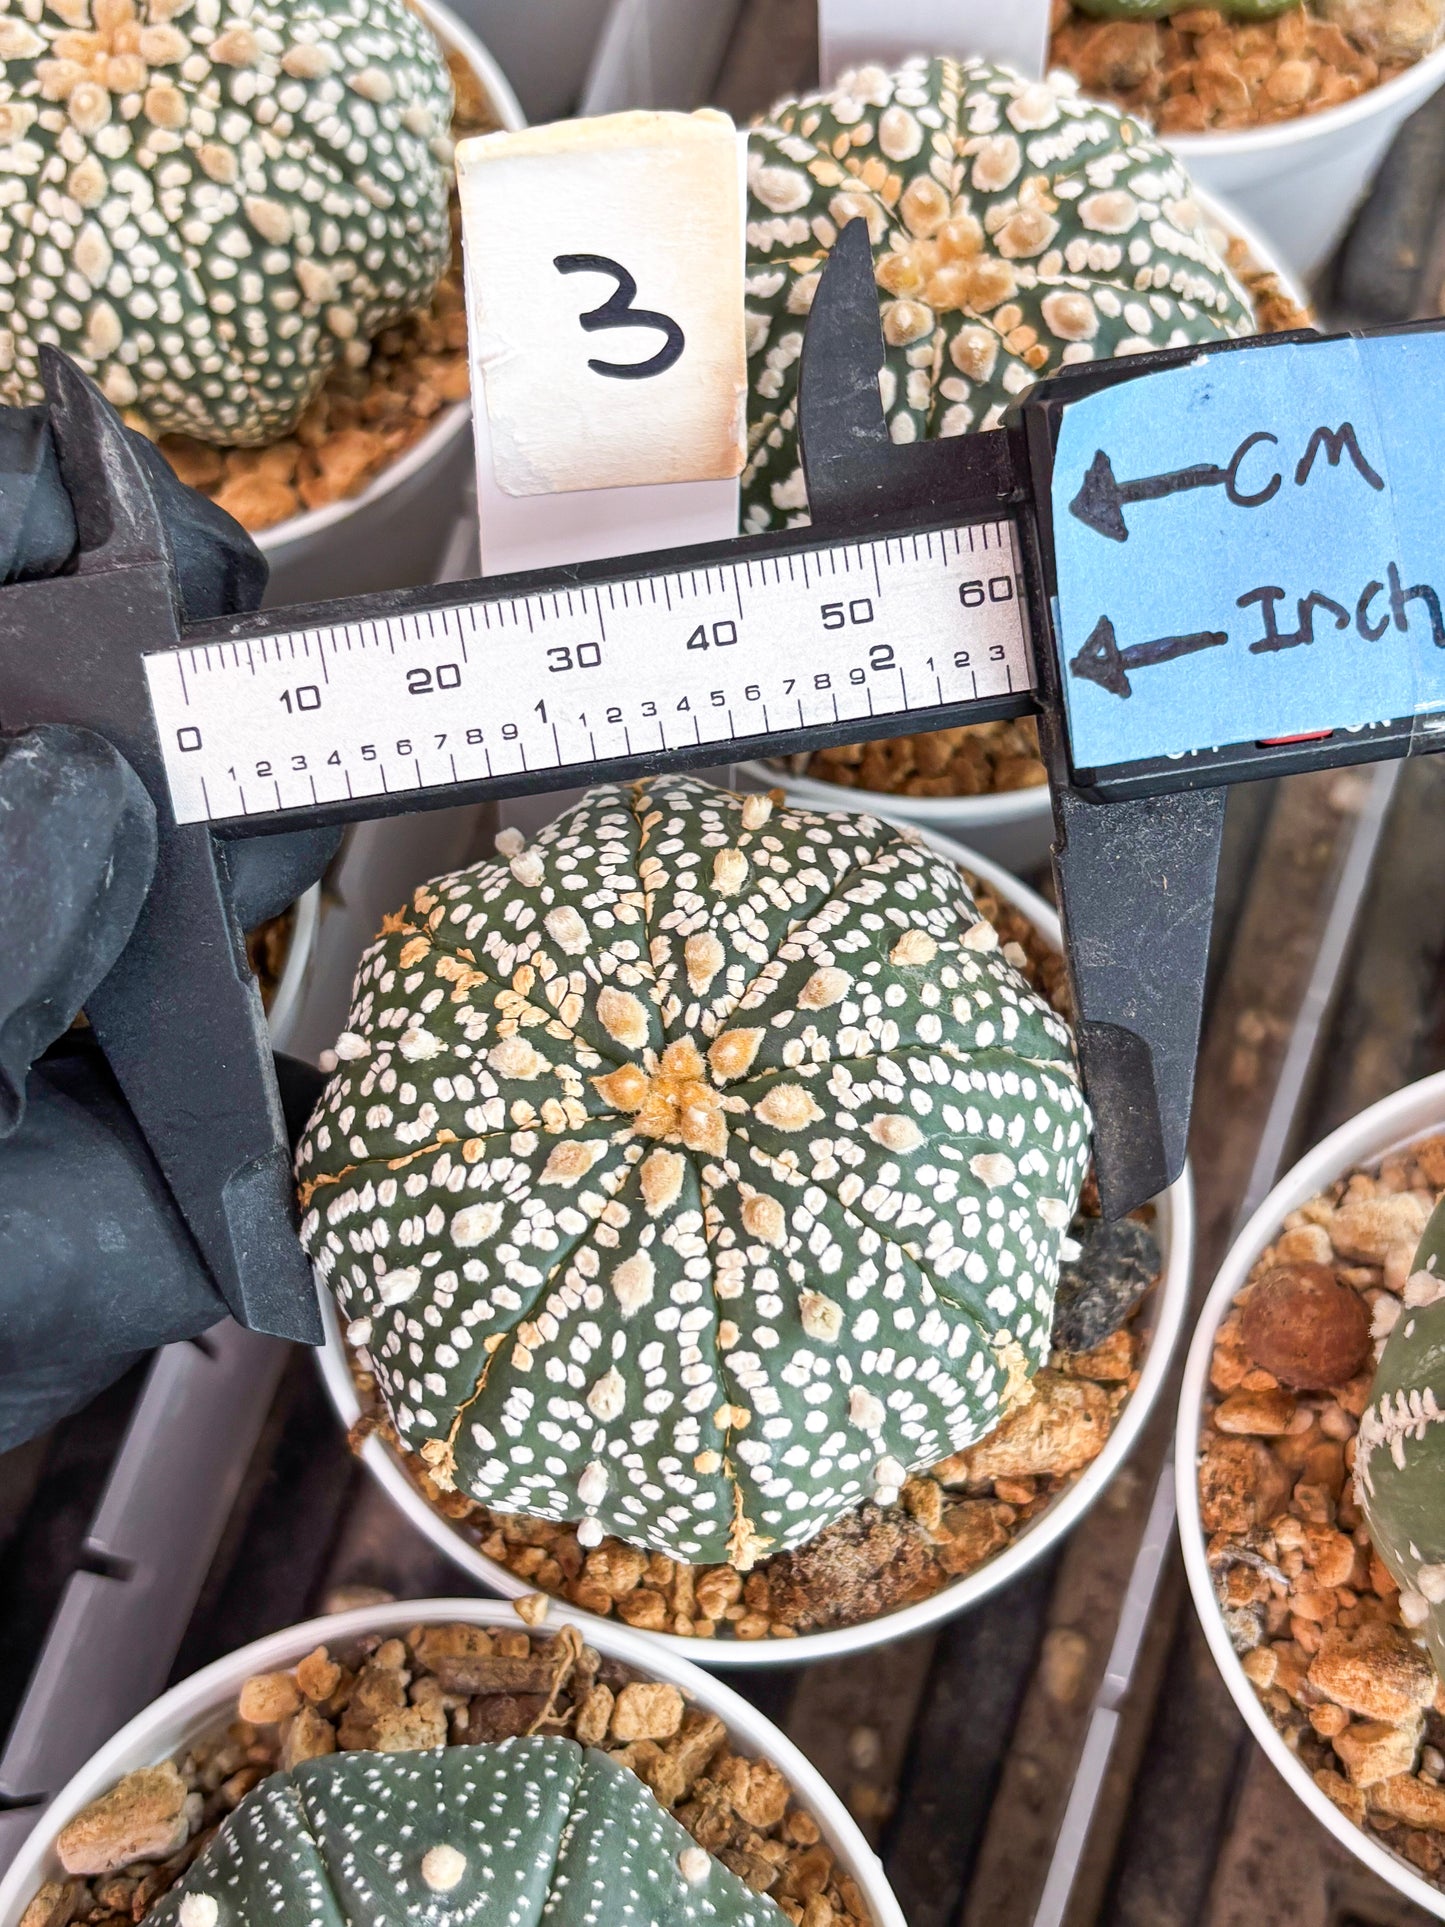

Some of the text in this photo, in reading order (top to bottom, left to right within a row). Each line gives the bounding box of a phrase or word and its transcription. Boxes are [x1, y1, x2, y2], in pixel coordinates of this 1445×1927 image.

[553, 253, 685, 380] 3
[176, 575, 1014, 753] 0 10 20 30 40 50 60
[1236, 561, 1445, 655] Inch
[226, 644, 1006, 781] 1 2 3 4 5 6 7 8 9 1 1 2 3 4 5 6 7 8 9 2 1 2 3
